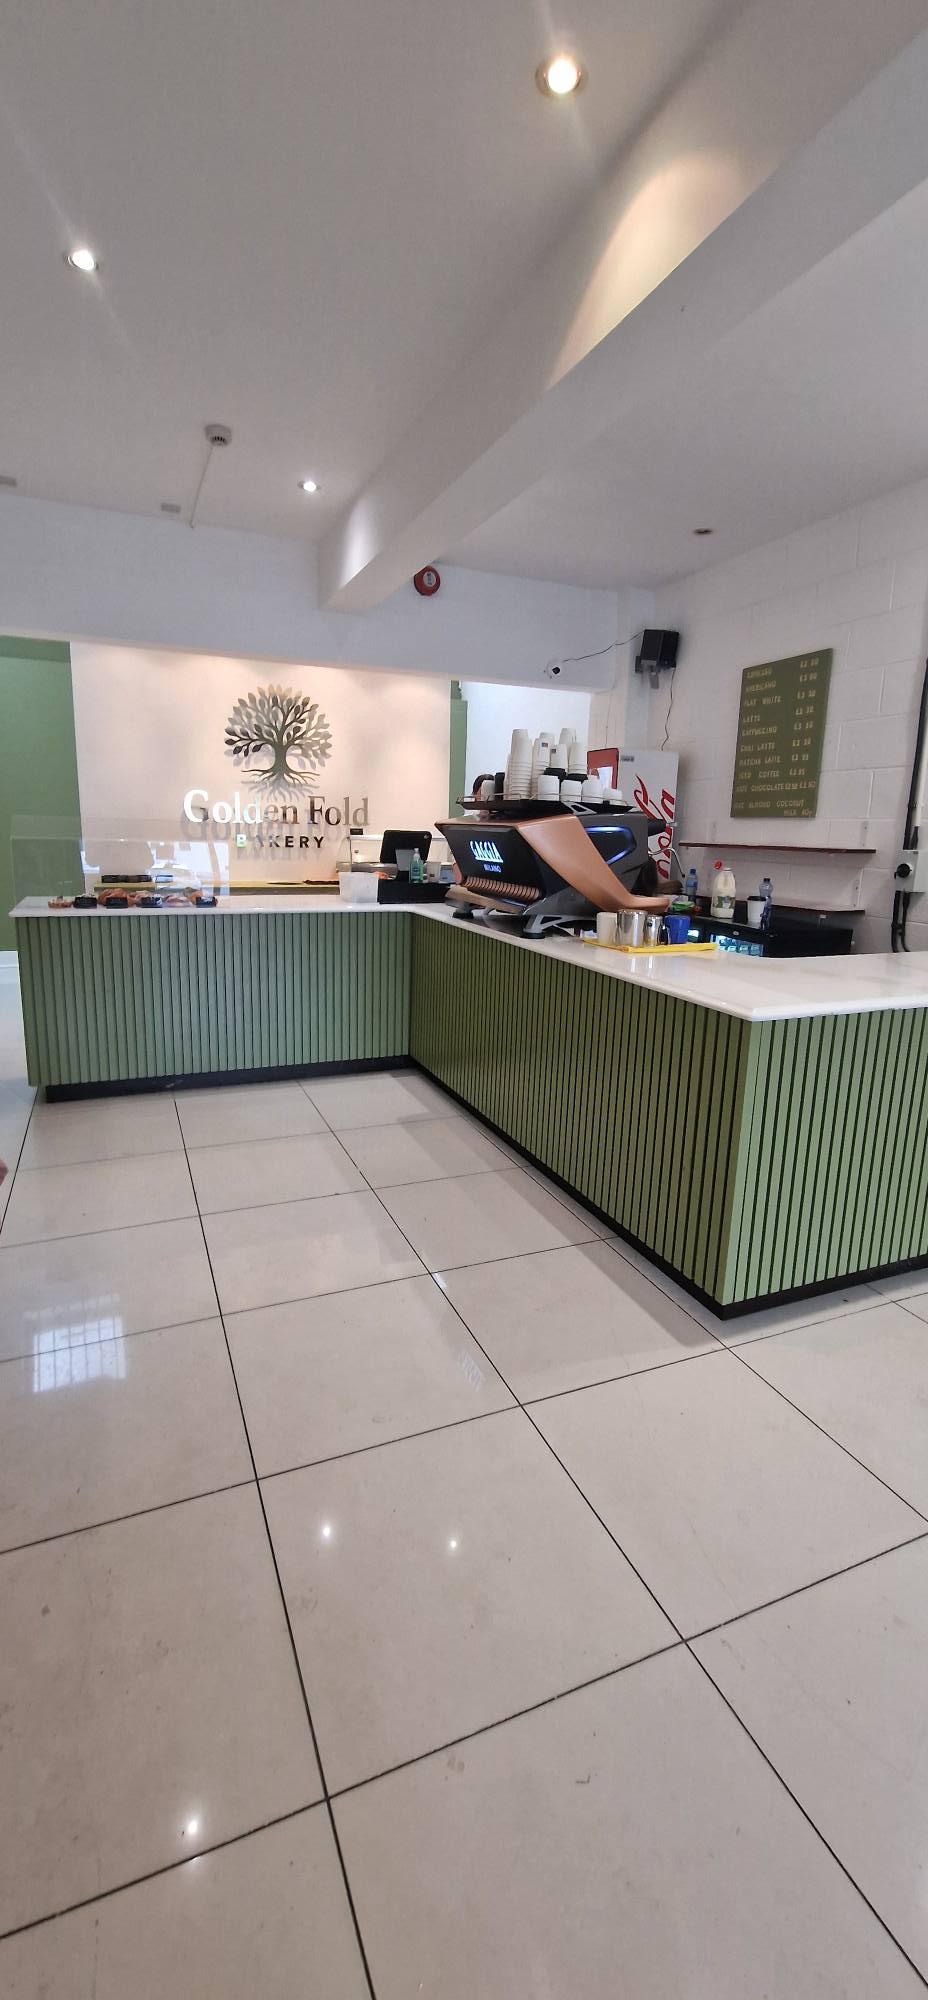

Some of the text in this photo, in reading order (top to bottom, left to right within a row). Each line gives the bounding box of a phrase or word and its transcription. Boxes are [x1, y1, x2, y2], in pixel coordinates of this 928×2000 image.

[745, 680, 777, 692] AMERICANO
[761, 695, 782, 705] WHITE
[742, 715, 760, 723] LATTE
[742, 726, 777, 736] CAPPUCCINO
[757, 742, 775, 751] LATTE
[739, 758, 761, 767] MATCHA
[764, 755, 781, 764] LATTE
[758, 770, 780, 778] COFFEE
[750, 783, 785, 792] CHOCOLATE
[183, 789, 370, 826] Golden Fold
[776, 799, 804, 807] COCONUT
[236, 833, 325, 849] BAKERY
[470, 841, 504, 863] GAGGIA
[484, 863, 502, 873] MILANO
